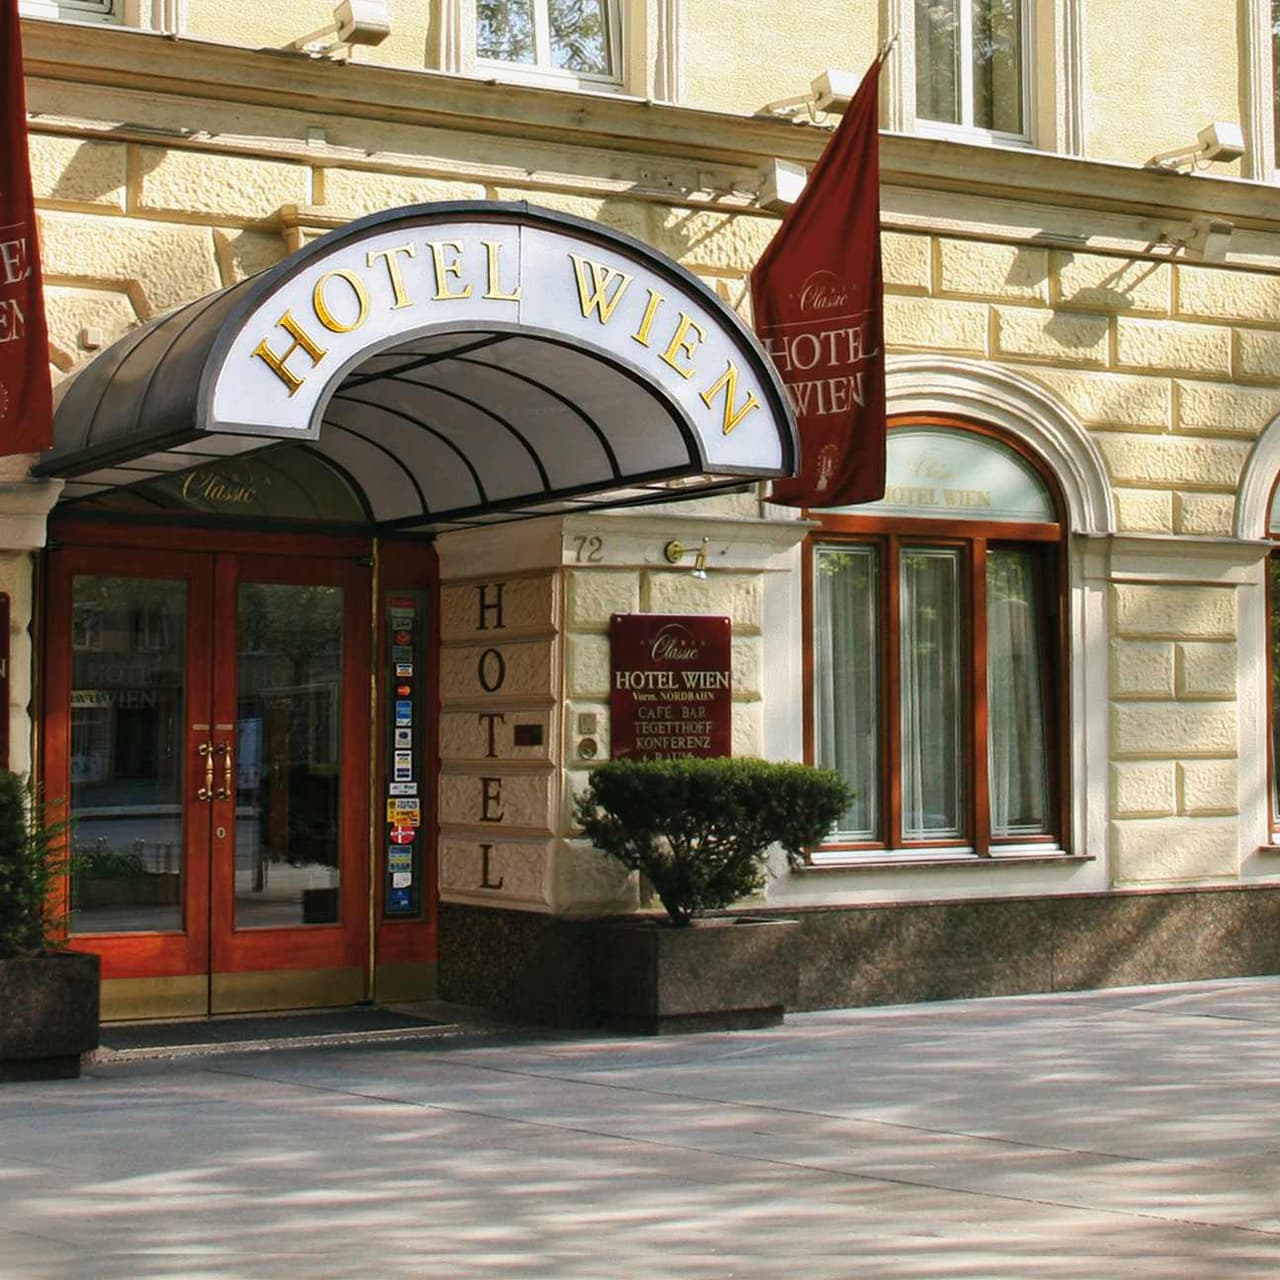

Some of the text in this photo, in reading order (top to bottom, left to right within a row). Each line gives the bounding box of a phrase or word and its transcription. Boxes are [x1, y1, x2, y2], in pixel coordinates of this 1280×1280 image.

[800, 284, 848, 312] Classic
[249, 238, 761, 436] HOTEL WIEN
[763, 324, 878, 371] HOTEL
[784, 372, 865, 418] WIEN
[182, 471, 257, 504] Classic
[572, 535, 605, 564] 72
[651, 633, 698, 662] Classic
[616, 671, 730, 689] HOTEL WIEN
[682, 706, 706, 719] BAR
[476, 583, 507, 890] HOTEL
[634, 721, 713, 734] TEGETTHOFF
[636, 736, 711, 749] KONFERENZ
